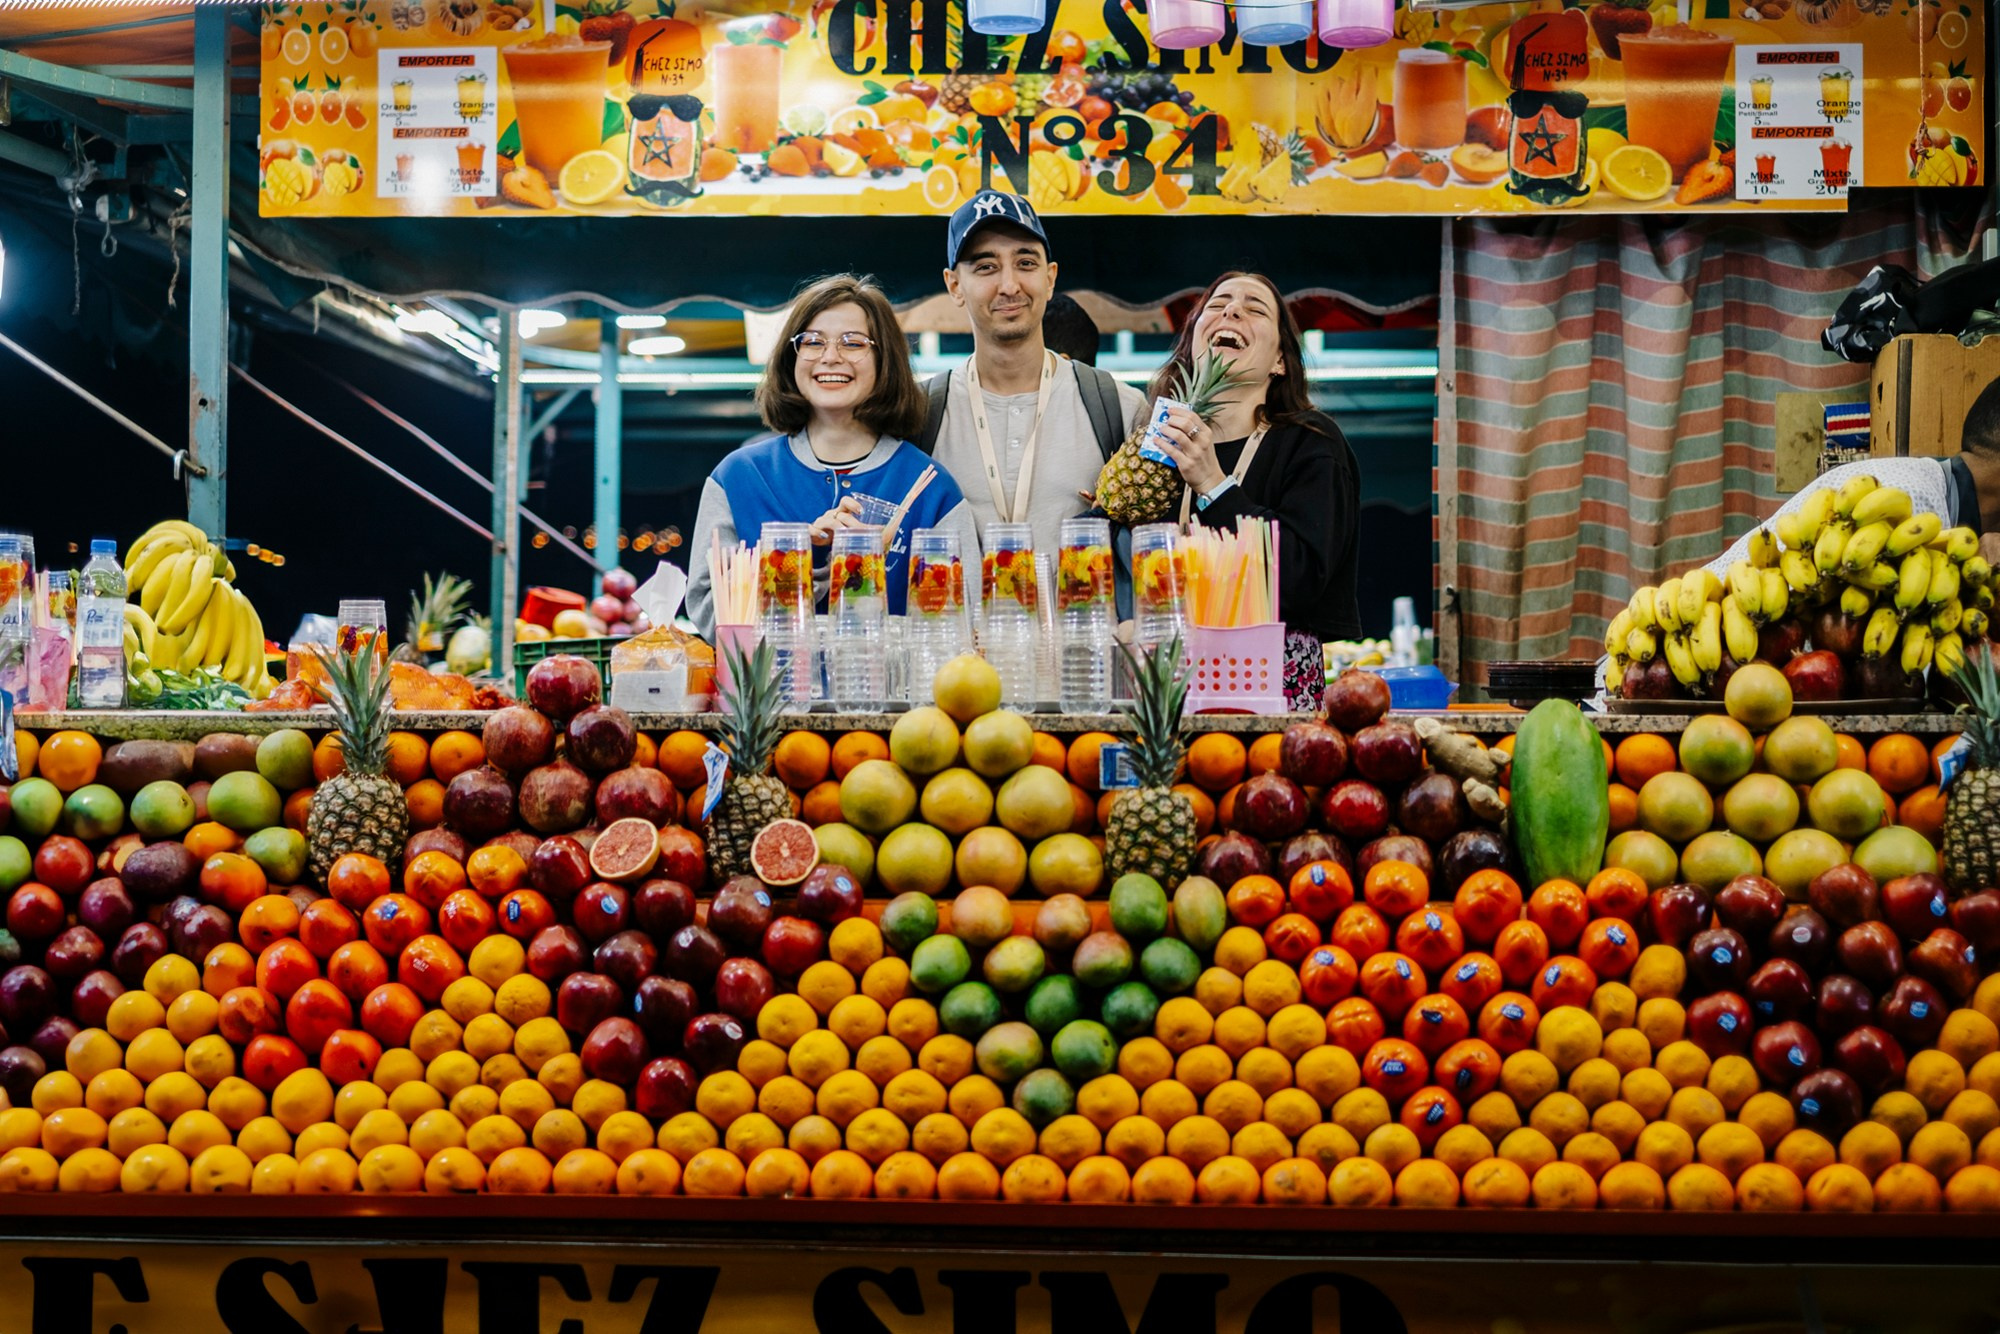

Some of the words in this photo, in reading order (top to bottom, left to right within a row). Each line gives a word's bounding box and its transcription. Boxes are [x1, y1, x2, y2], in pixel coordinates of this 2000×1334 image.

[398, 55, 470, 67] EMPORTER
[1525, 52, 1553, 67] CHEZ
[1556, 52, 1587, 67] SIMO
[1757, 51, 1835, 63] EMPORTER
[643, 57, 670, 71] CHEZ
[674, 57, 703, 72] SIMO
[381, 103, 417, 111] Orange
[453, 101, 495, 109] Orange
[1738, 101, 1778, 110] Orange
[1816, 99, 1861, 108] Orange
[462, 114, 478, 125] 10
[1754, 116, 1762, 126] 5
[1825, 114, 1843, 124] 10
[396, 128, 468, 138] EMPORTER
[1755, 127, 1833, 138] EMPORTER
[975, 115, 1225, 196] N°34
[450, 168, 485, 176] Mixte
[1750, 171, 1779, 180] Mixte
[1813, 169, 1852, 178] Mixte
[452, 182, 472, 193] 20
[1753, 184, 1769, 195] 10
[1815, 184, 1838, 195] 20
